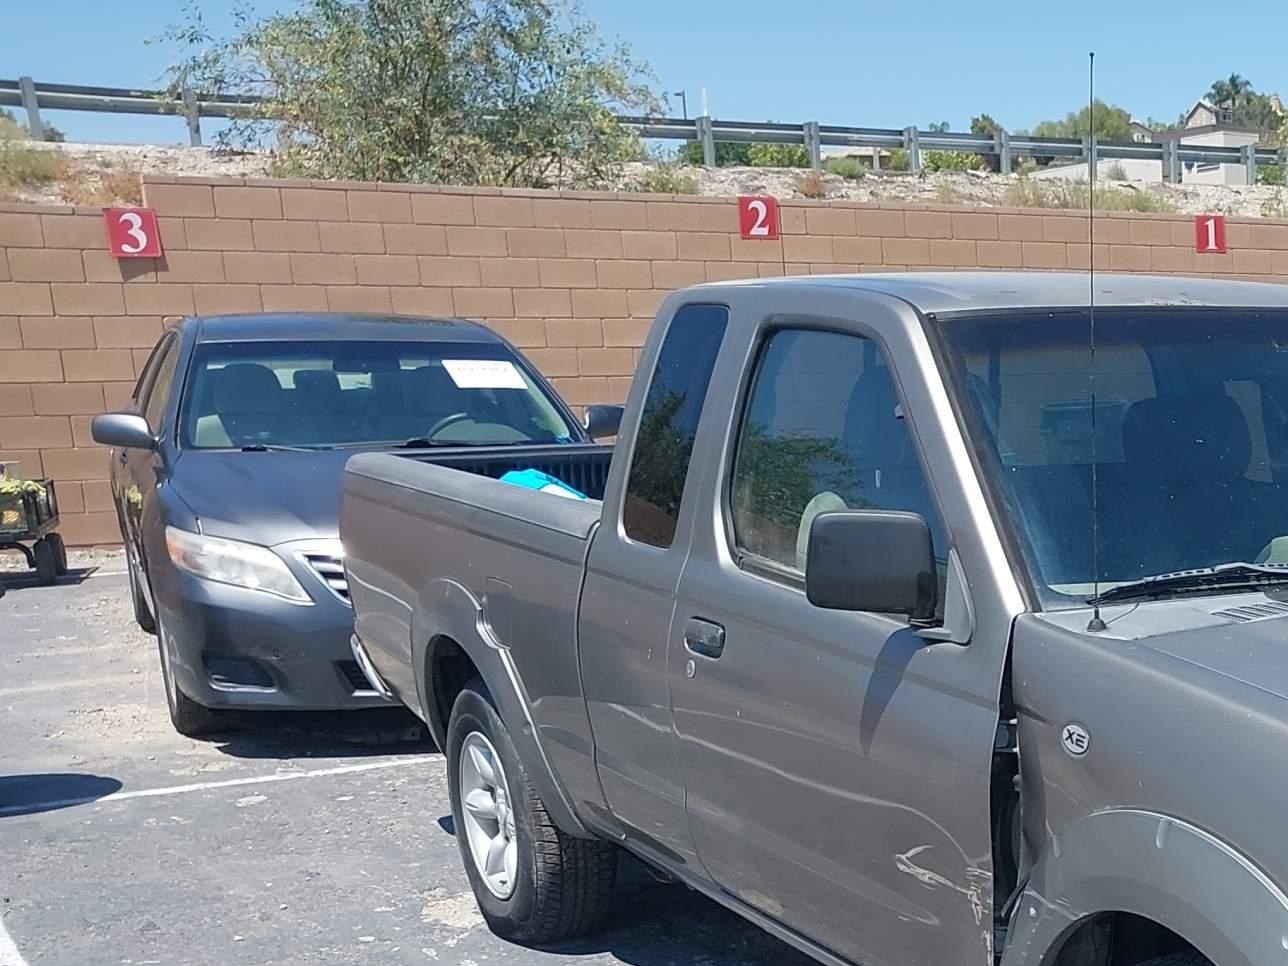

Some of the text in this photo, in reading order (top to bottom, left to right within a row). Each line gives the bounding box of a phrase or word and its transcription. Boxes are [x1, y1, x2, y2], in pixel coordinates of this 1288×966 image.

[119, 212, 147, 253] 3
[748, 200, 770, 236] 2
[1204, 219, 1219, 250] 1
[1064, 728, 1086, 749] XE
